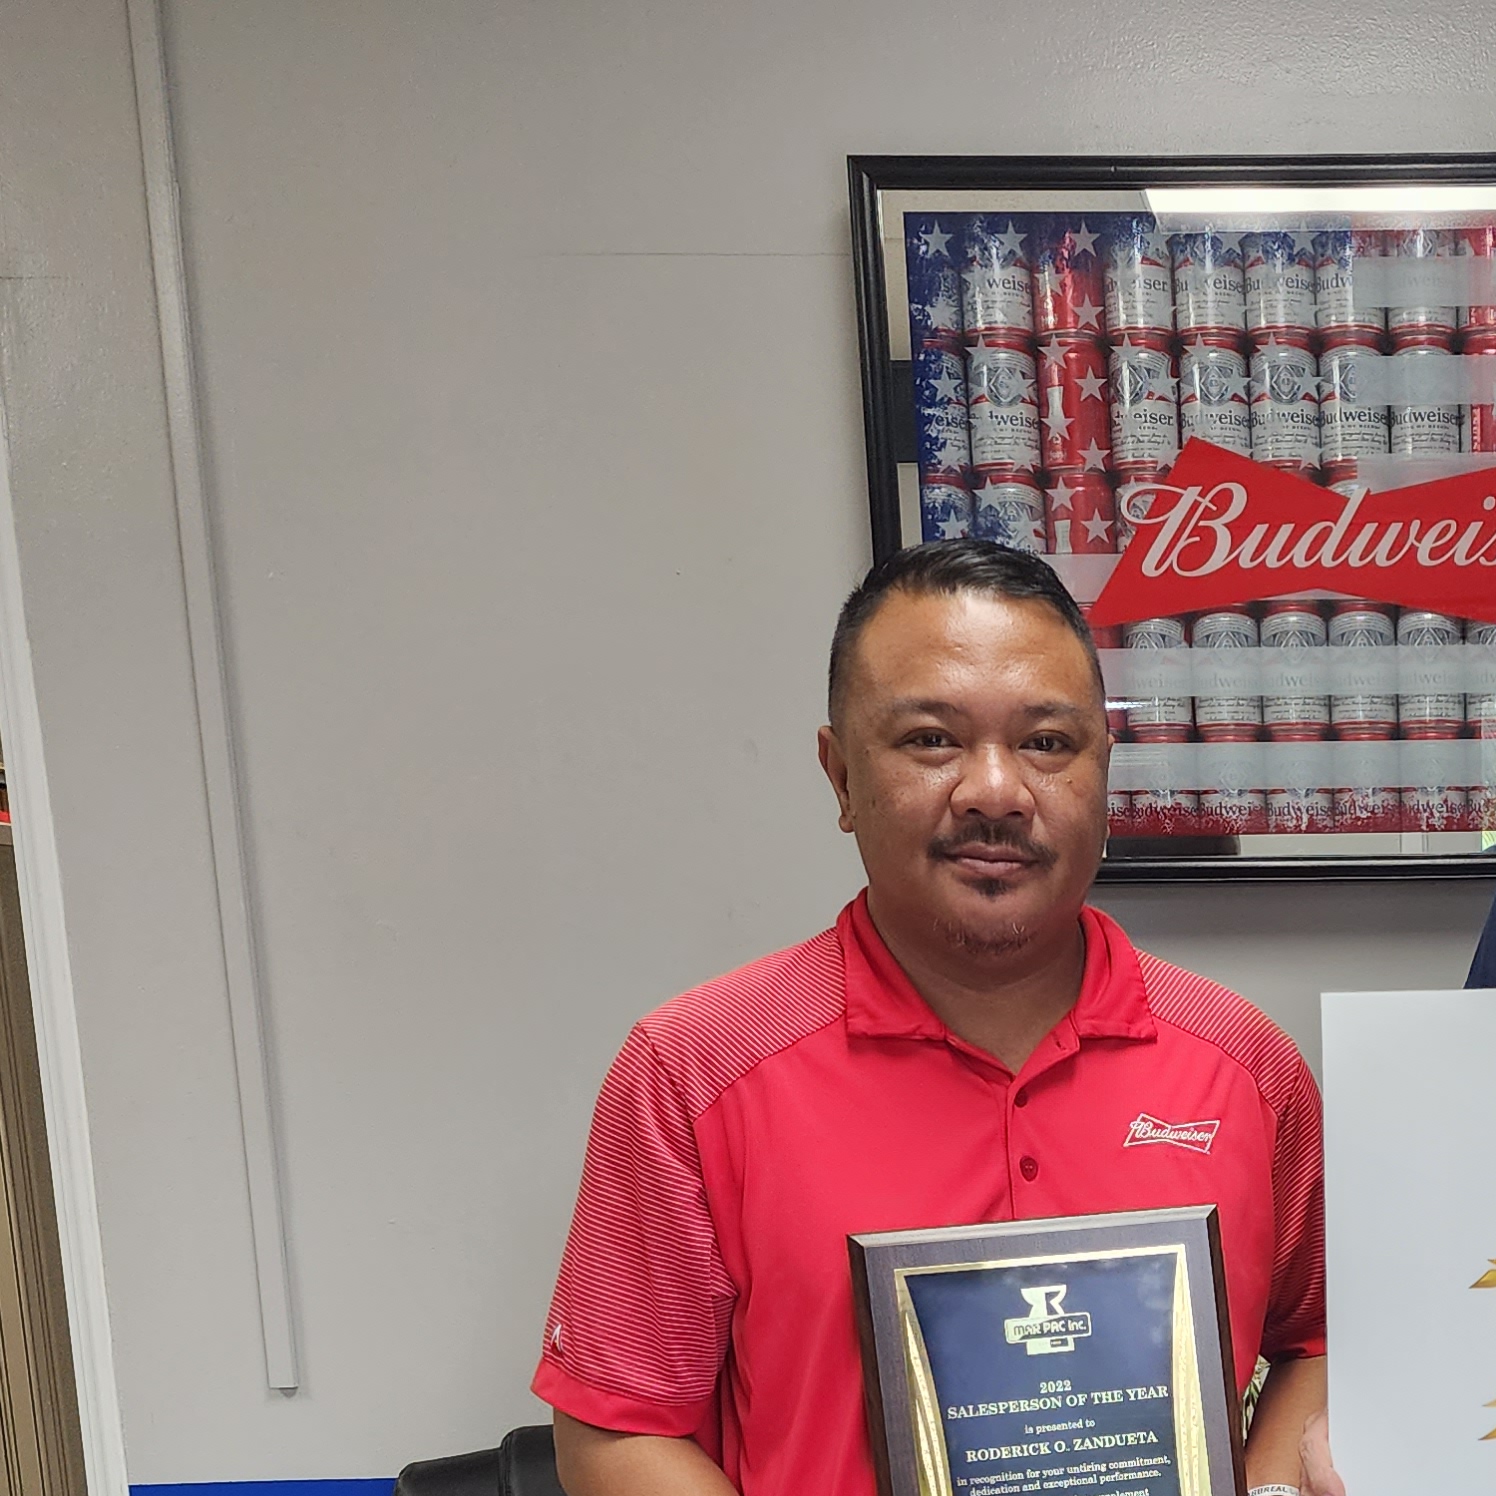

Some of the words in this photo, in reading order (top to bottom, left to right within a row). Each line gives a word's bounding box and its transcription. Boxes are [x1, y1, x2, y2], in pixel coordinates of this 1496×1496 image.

[1129, 1120, 1212, 1142] Budweiser
[1013, 1323, 1041, 1336] MAR
[1043, 1320, 1066, 1334] PAC
[1040, 1379, 1072, 1394] 2022
[947, 1396, 1062, 1420] SALESPERSON
[1065, 1394, 1087, 1407] OF
[1091, 1390, 1124, 1405] THE
[1126, 1385, 1169, 1401] YEAR
[1036, 1419, 1083, 1435] presented
[1085, 1419, 1095, 1428] to
[965, 1442, 1051, 1463] RODERICK
[1053, 1440, 1070, 1453] O.
[1072, 1431, 1159, 1451] ZANDUETA
[956, 1477, 968, 1487] in
[969, 1471, 1024, 1485] recognition
[1025, 1468, 1041, 1479] for
[1041, 1467, 1065, 1479] your
[1066, 1462, 1107, 1474] untiring
[1108, 1455, 1171, 1470] commitment,
[1022, 1480, 1041, 1492] and
[1043, 1474, 1098, 1489] exceptional
[1099, 1469, 1162, 1485] performance.
